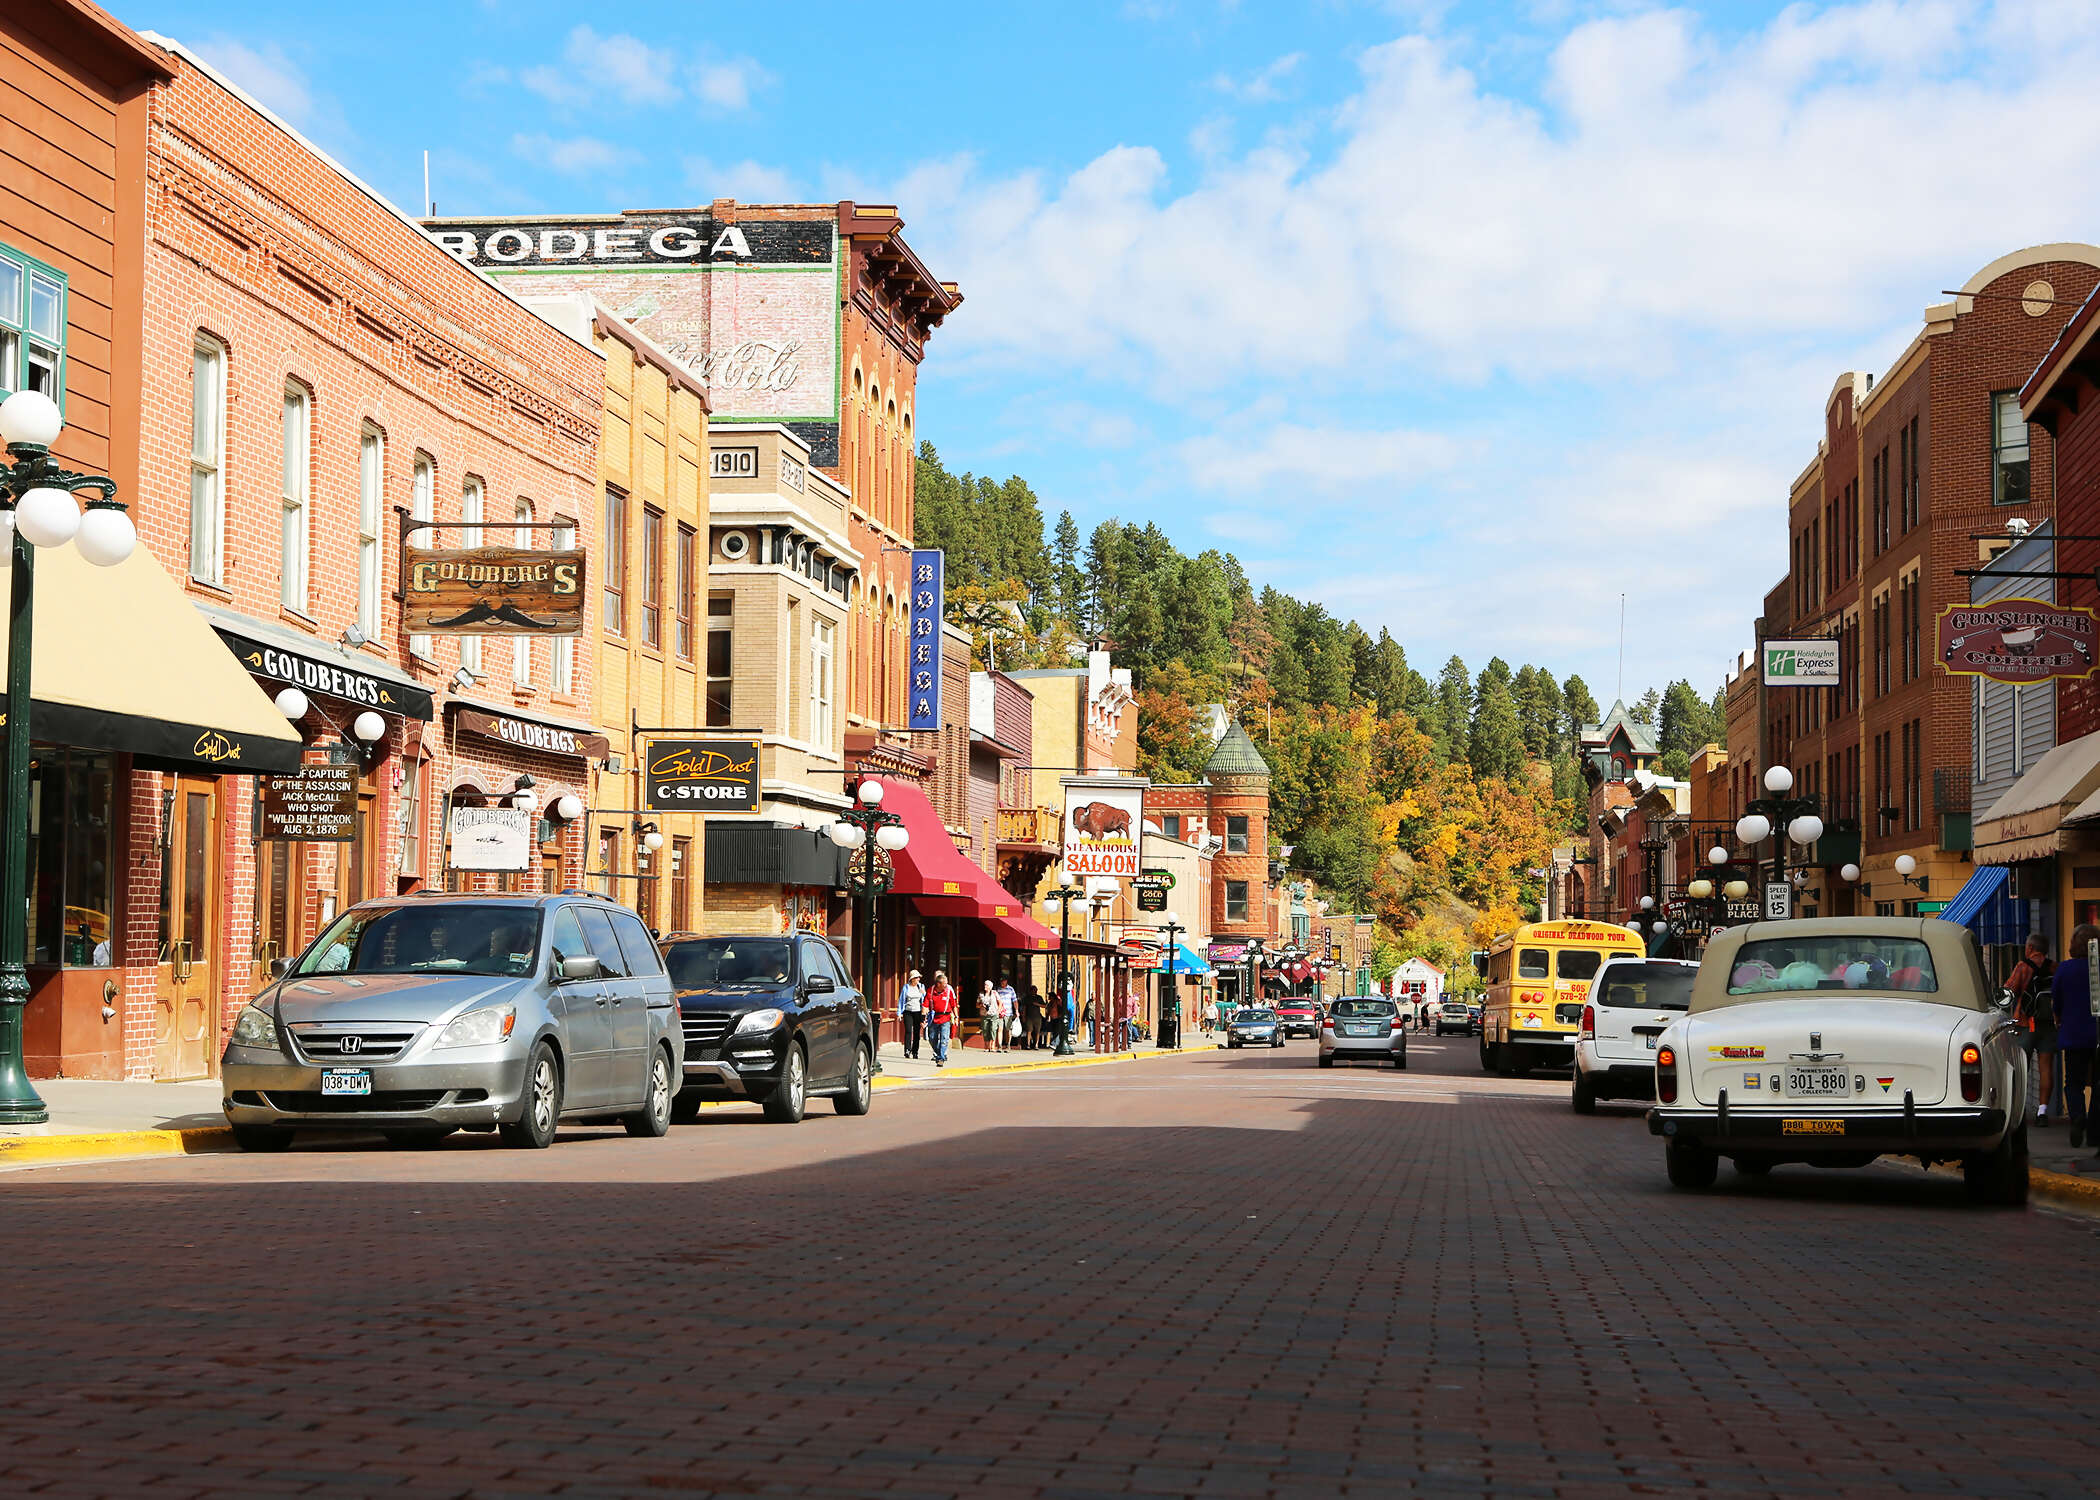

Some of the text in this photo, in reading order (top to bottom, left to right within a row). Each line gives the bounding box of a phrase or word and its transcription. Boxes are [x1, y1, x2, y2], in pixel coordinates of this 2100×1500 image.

[432, 226, 752, 262] BODEGA
[715, 453, 750, 472] 1910
[412, 559, 577, 594] GOLDBERG'S
[1951, 611, 2092, 634] GUNSLINGER
[915, 564, 934, 716] BODEGA
[1797, 650, 1823, 658] Holiday
[1964, 651, 2074, 667] COFFEE
[1797, 658, 1834, 669] Express
[264, 649, 379, 704] GOLDBERG'S
[499, 718, 575, 752] GOLDBERG'S
[650, 748, 756, 777] Gold Dust
[309, 769, 349, 779] CAPTURE
[272, 780, 351, 791] OF THE ASSASSIN
[281, 792, 342, 802] JACK McCALL
[287, 803, 334, 812] WHO SHOT
[268, 814, 352, 824] "WILD BILL" HICKOK
[283, 825, 338, 836] AUG 2, 1876
[1065, 843, 1138, 854] STEAKHOUSE
[1066, 854, 1137, 874] SALOON
[1727, 903, 1759, 911] UTTER
[1770, 902, 1785, 915] 15
[1533, 930, 1626, 941] ORIGINAL DEADWOOD TOUR
[1571, 984, 1586, 993] 605
[324, 1076, 343, 1089] 038
[1790, 1074, 1846, 1089] 301-880
[1811, 1120, 1844, 1129] TOWN
